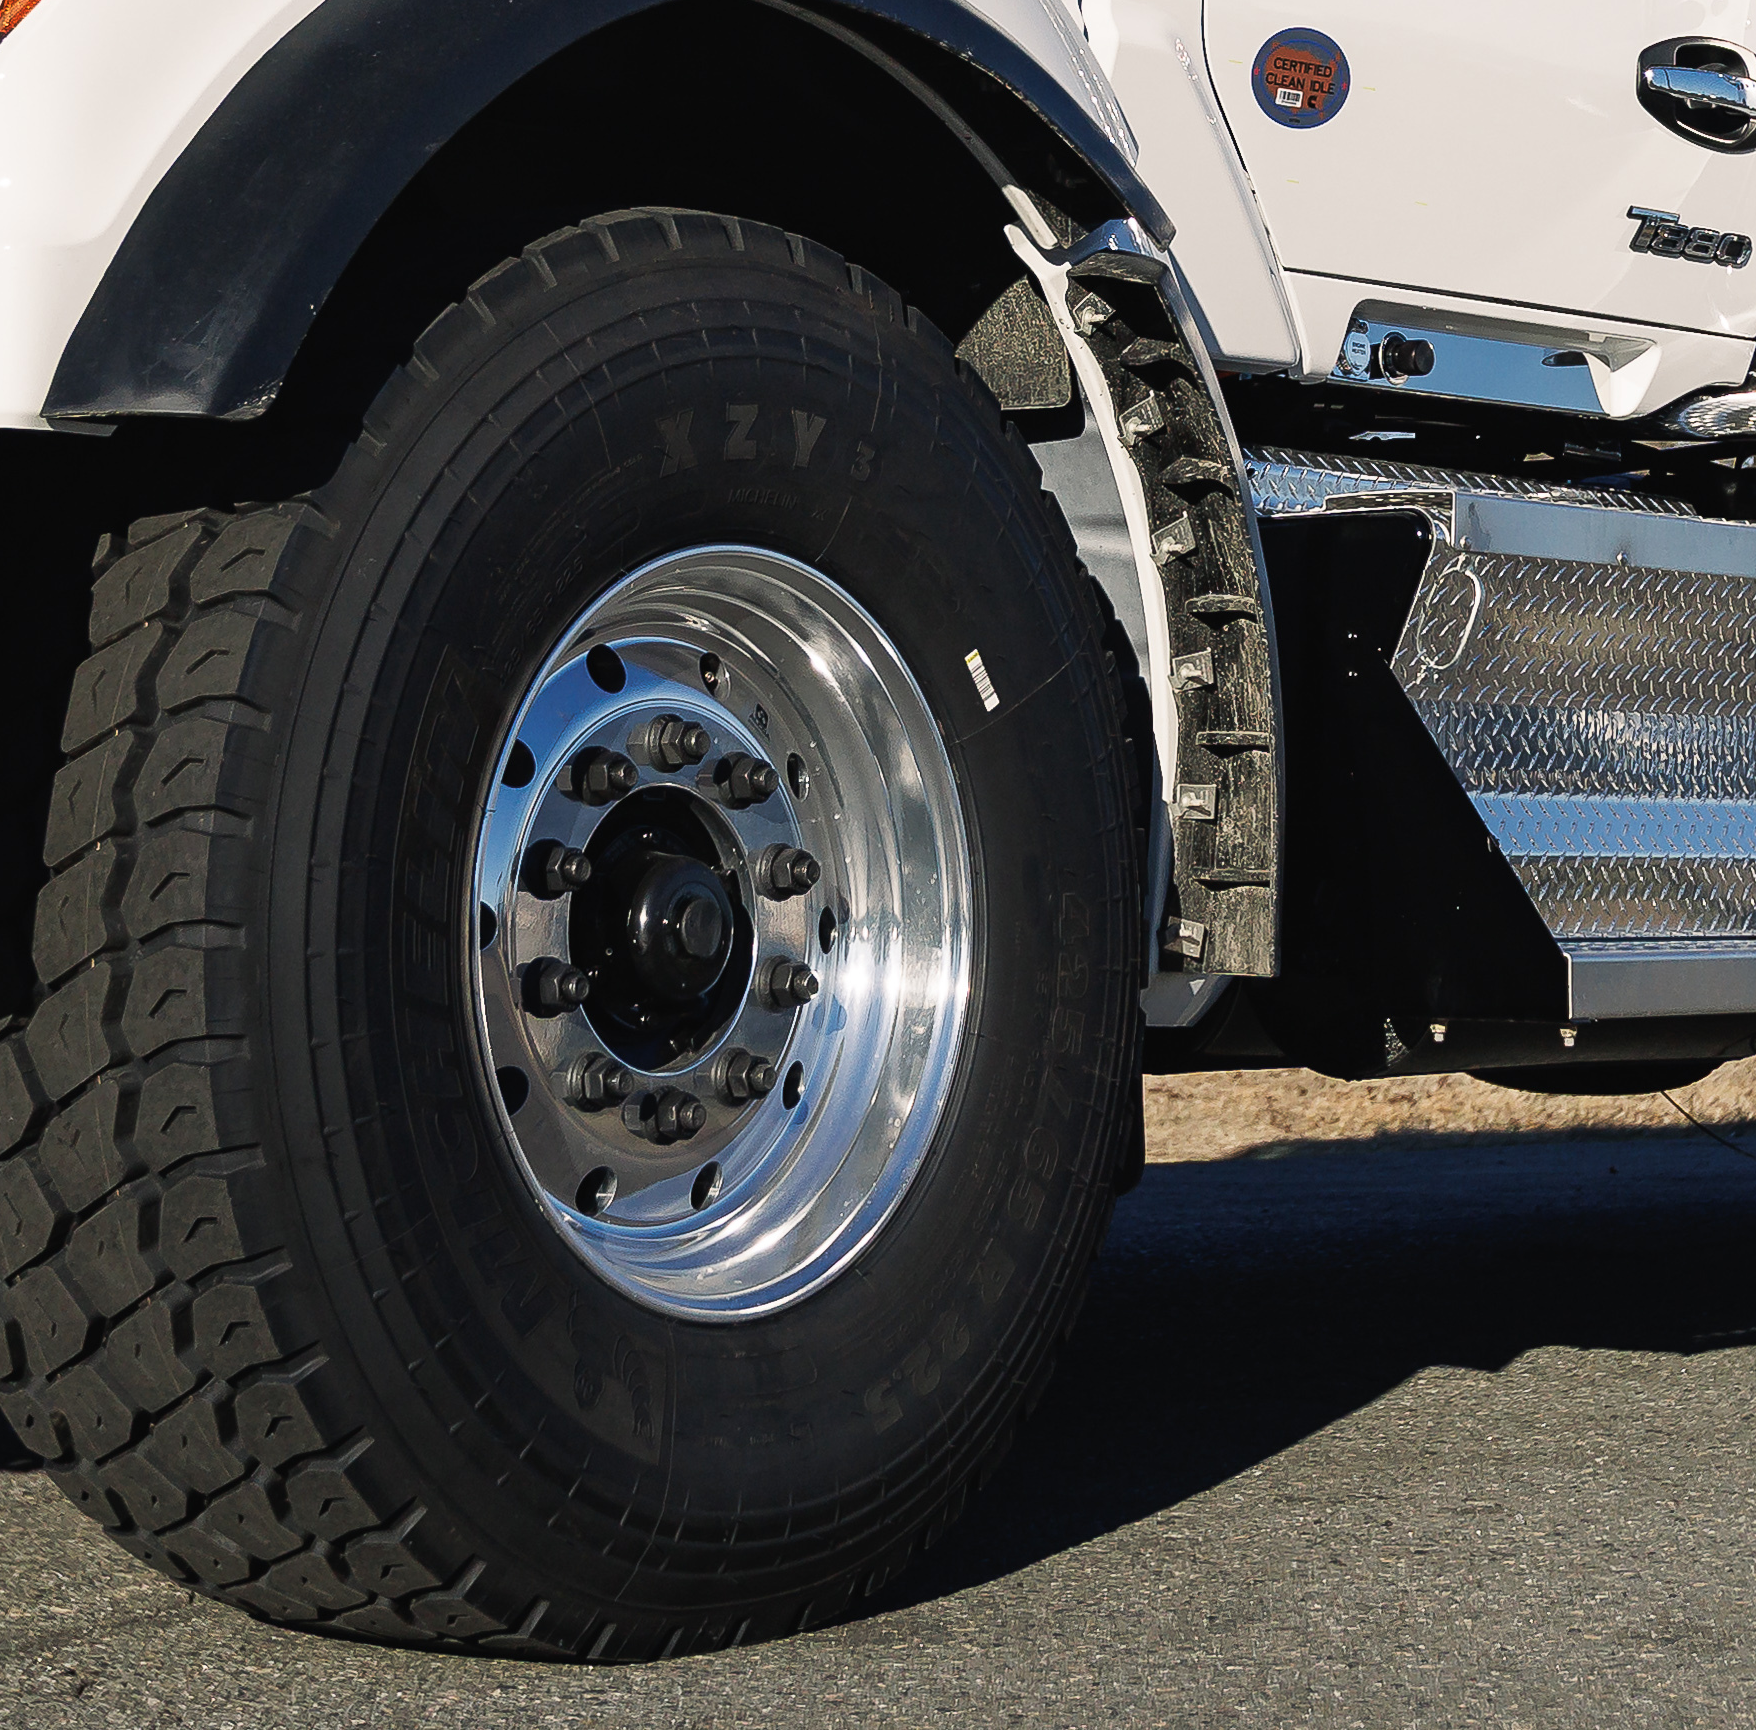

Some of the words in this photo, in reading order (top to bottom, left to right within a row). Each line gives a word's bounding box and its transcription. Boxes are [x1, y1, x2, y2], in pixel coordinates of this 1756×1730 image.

[1274, 57, 1332, 78] CERTIFIED
[1265, 72, 1306, 90] CLEAN
[1309, 80, 1336, 96] IDLE
[1626, 205, 1753, 269] T880
[726, 487, 800, 511] MICHELIN
[403, 667, 560, 1339] MICHELIN
